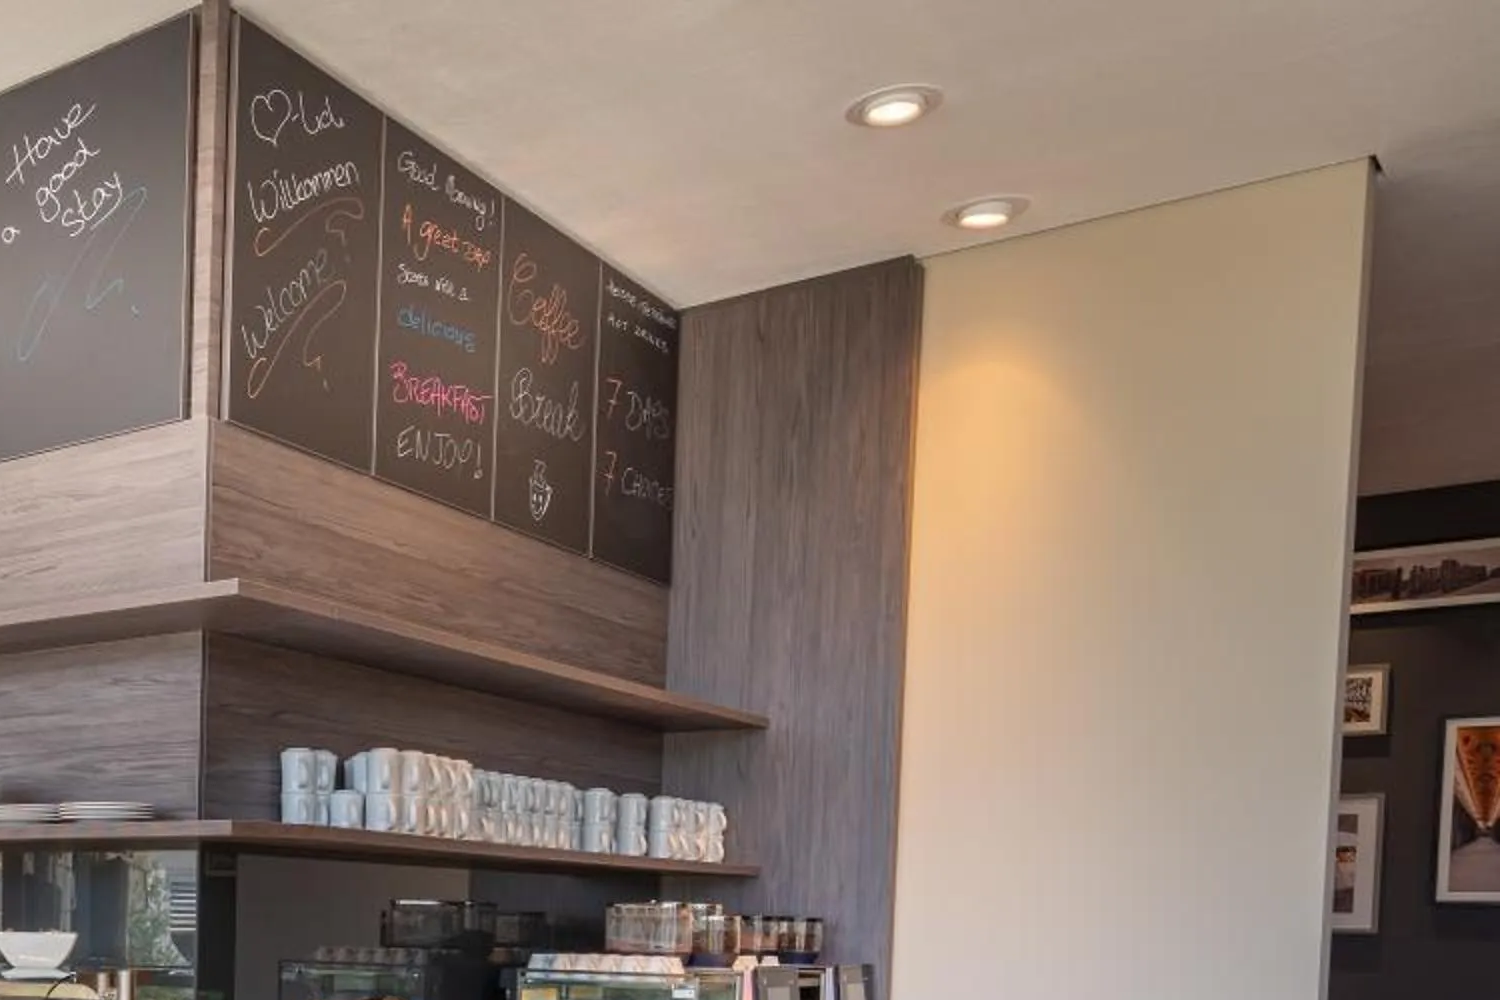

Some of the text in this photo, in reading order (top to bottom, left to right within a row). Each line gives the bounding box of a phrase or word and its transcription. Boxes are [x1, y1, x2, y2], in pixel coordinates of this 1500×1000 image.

[5, 103, 97, 184] Have
[1, 137, 101, 244] a good
[247, 160, 361, 223] Willkommen
[240, 248, 329, 358] Welcome
[507, 252, 589, 366] Coffee
[509, 367, 584, 442] Break
[605, 377, 622, 420] 7
[603, 450, 618, 497] 7
